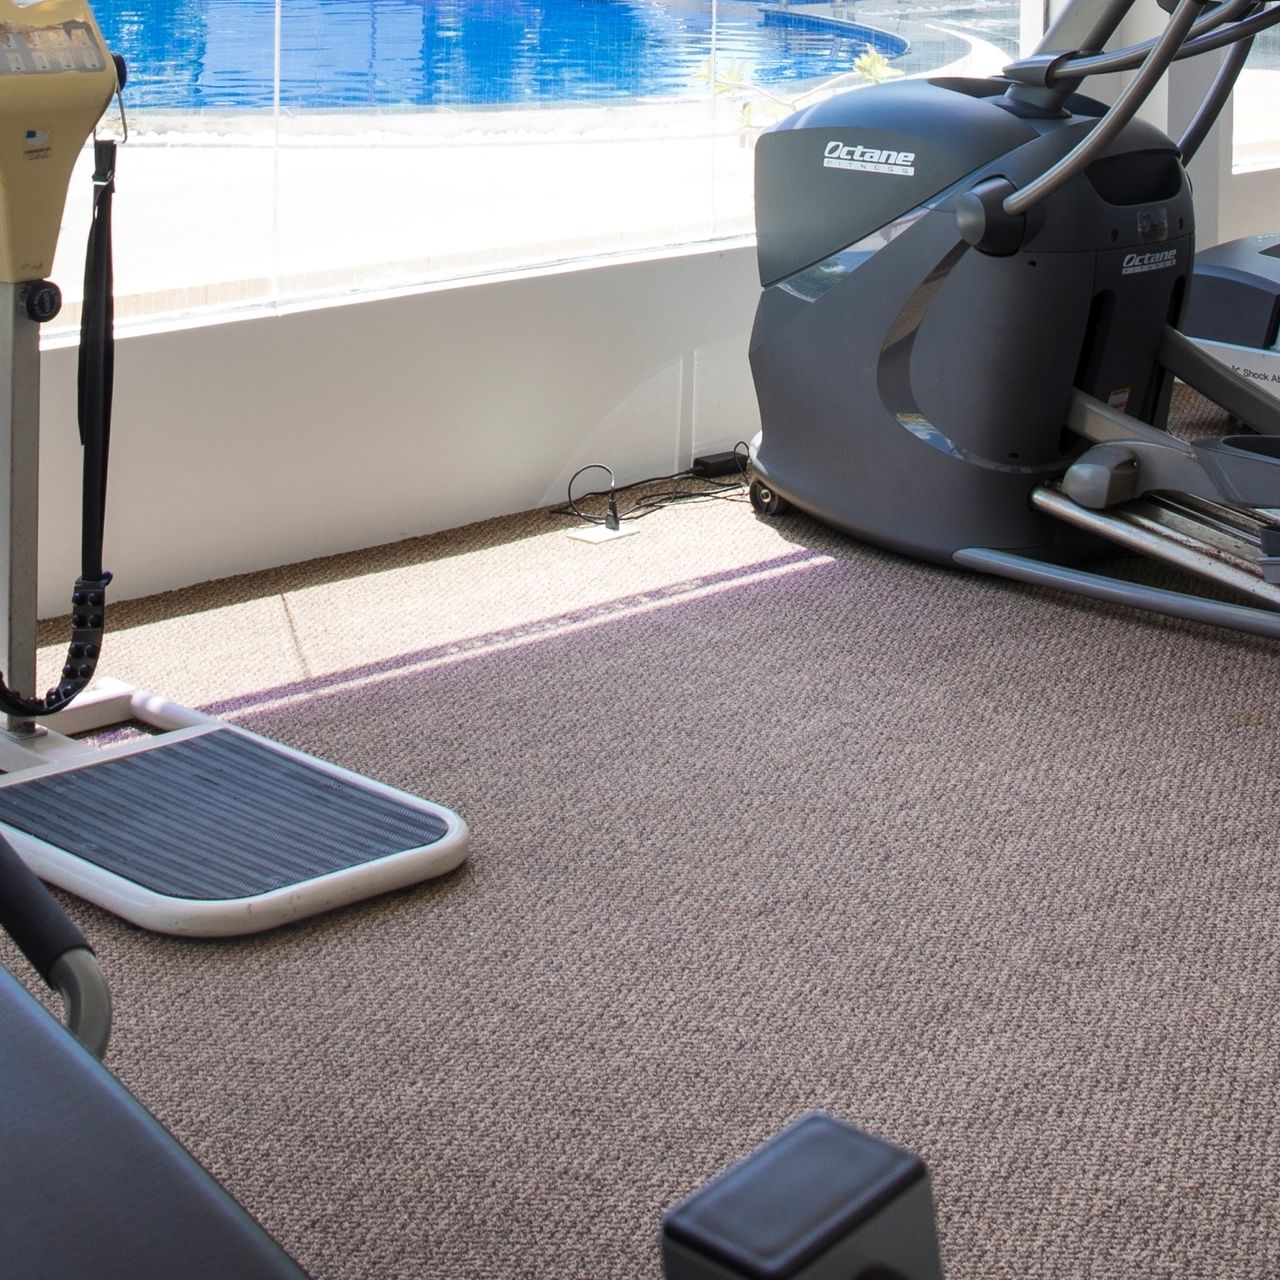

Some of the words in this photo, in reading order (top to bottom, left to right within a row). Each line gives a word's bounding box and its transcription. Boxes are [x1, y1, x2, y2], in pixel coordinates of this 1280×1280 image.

[824, 140, 916, 166] Octane
[1123, 249, 1177, 267] Octane
[1243, 368, 1270, 382] Shock
